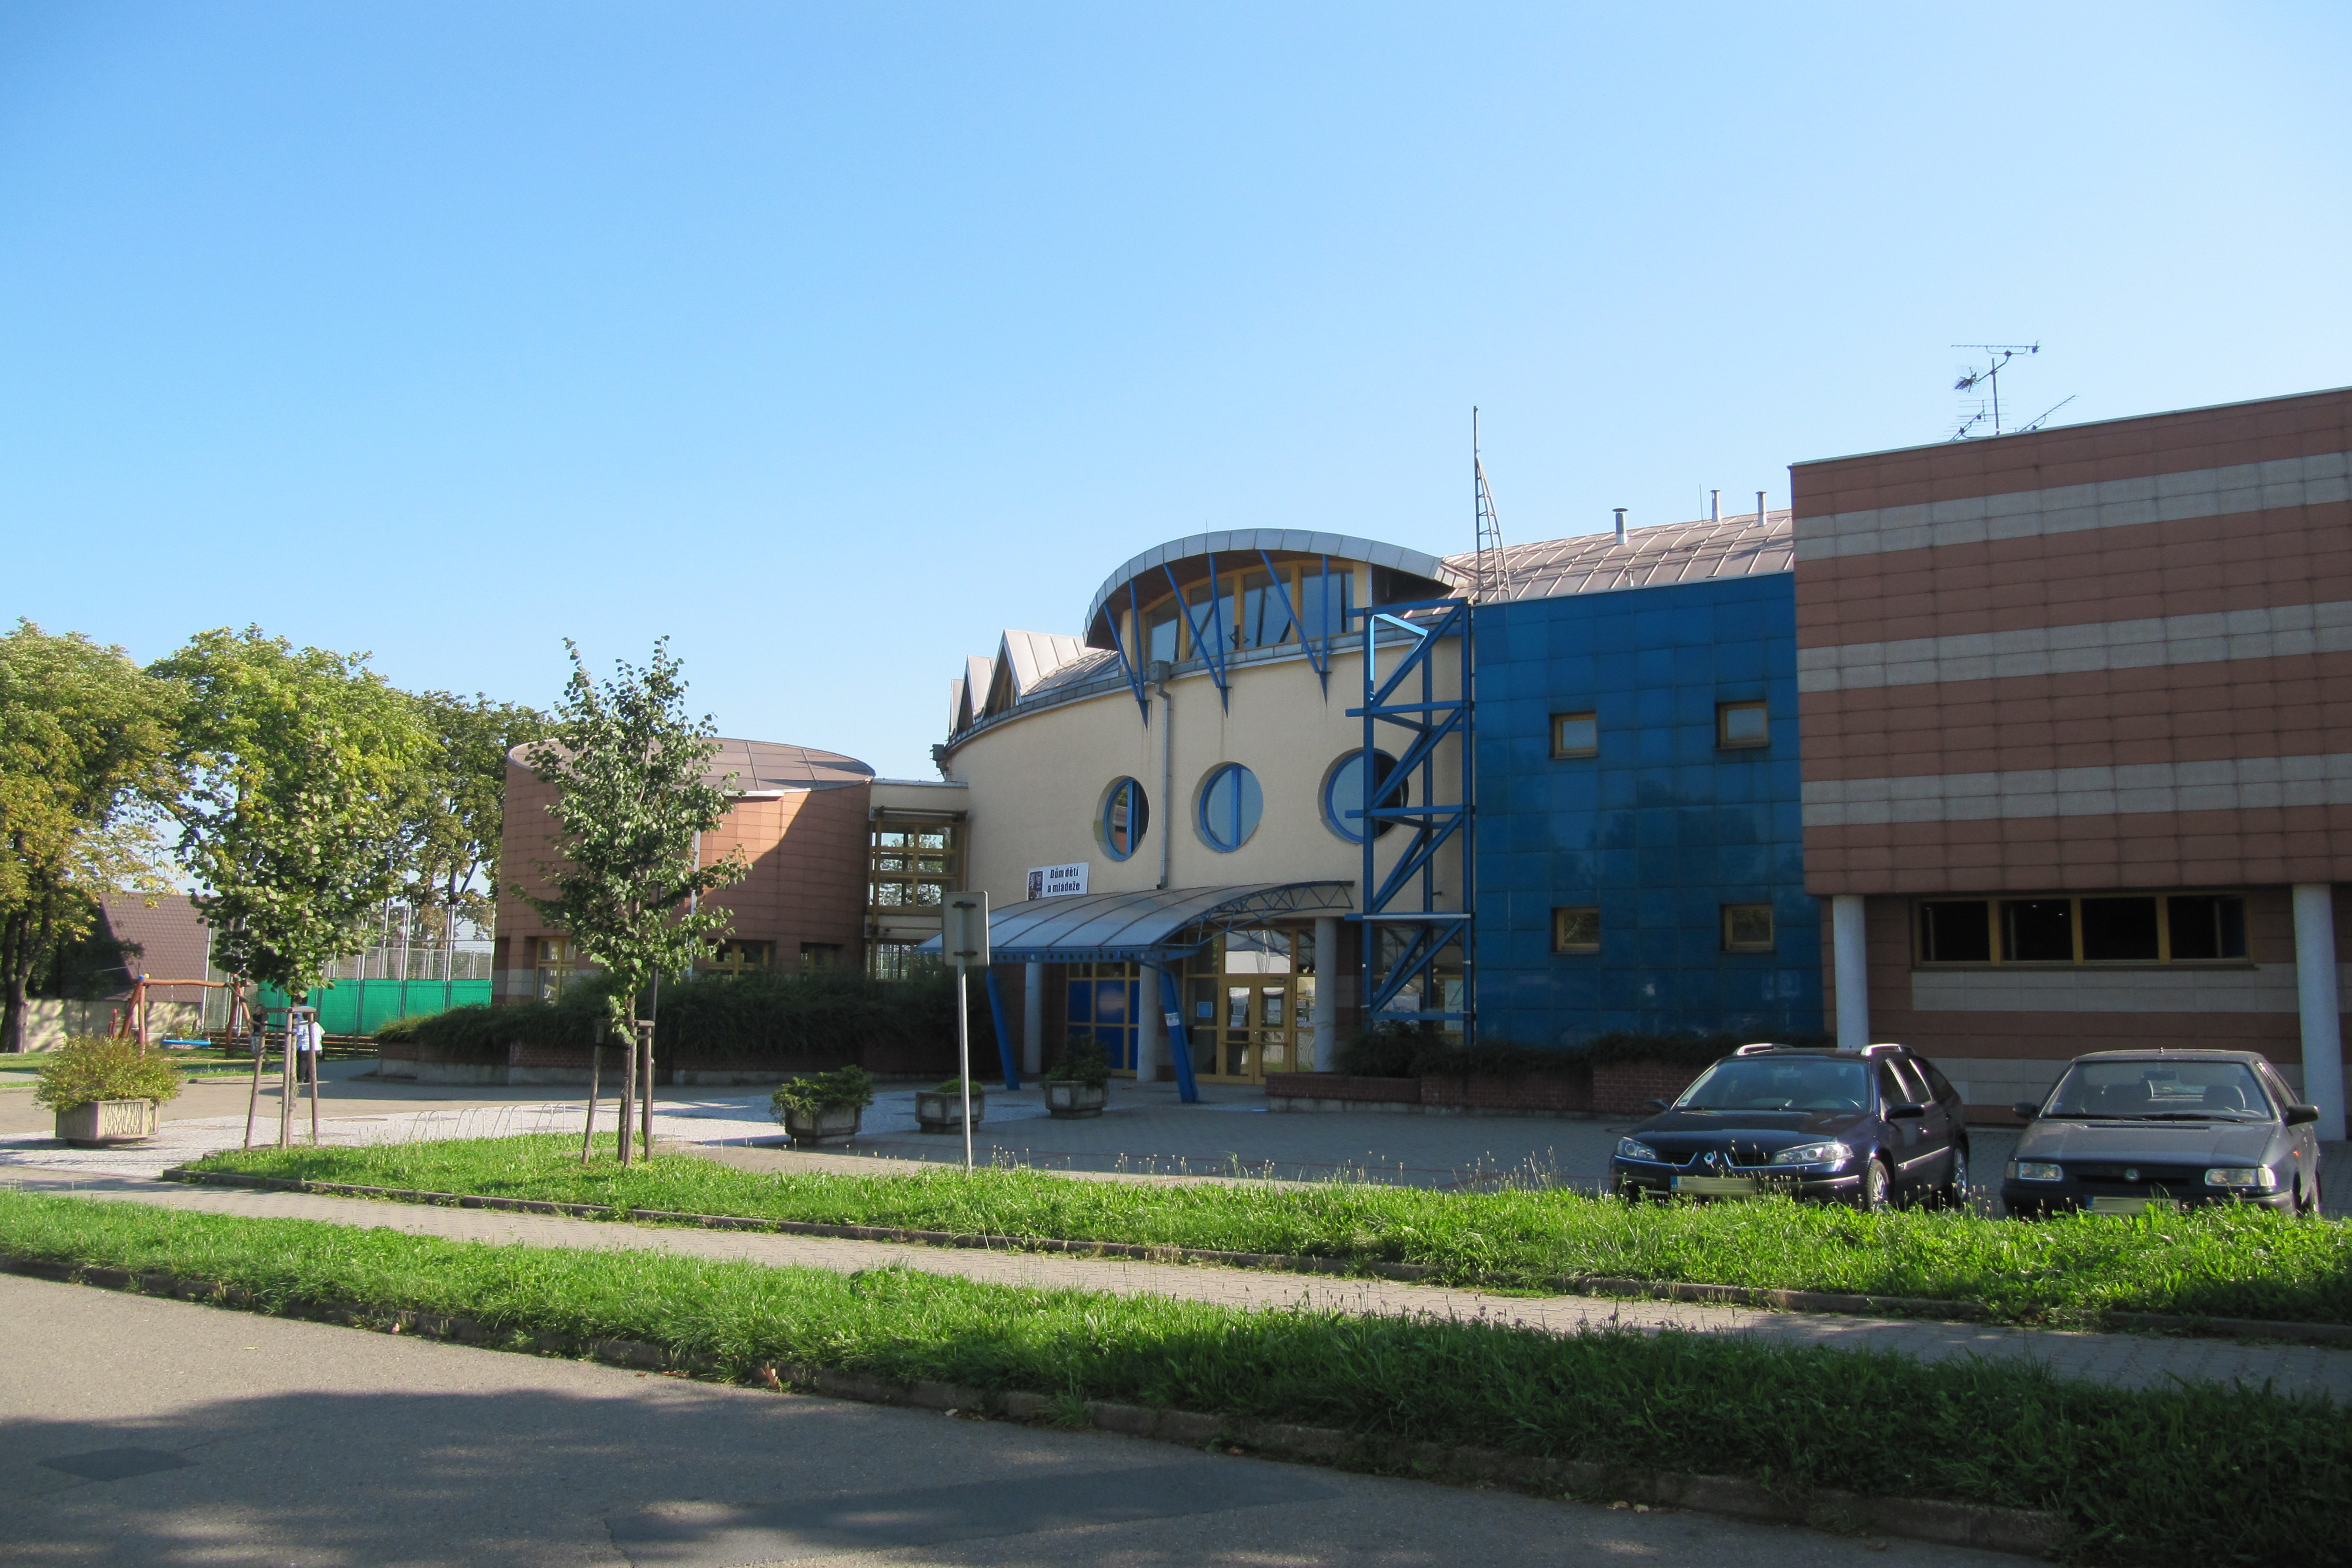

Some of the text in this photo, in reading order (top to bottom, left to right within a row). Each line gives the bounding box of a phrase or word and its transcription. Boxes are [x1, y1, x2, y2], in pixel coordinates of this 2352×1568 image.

[1050, 867, 1064, 878] Dům
[1047, 881, 1080, 892] a mládeže
